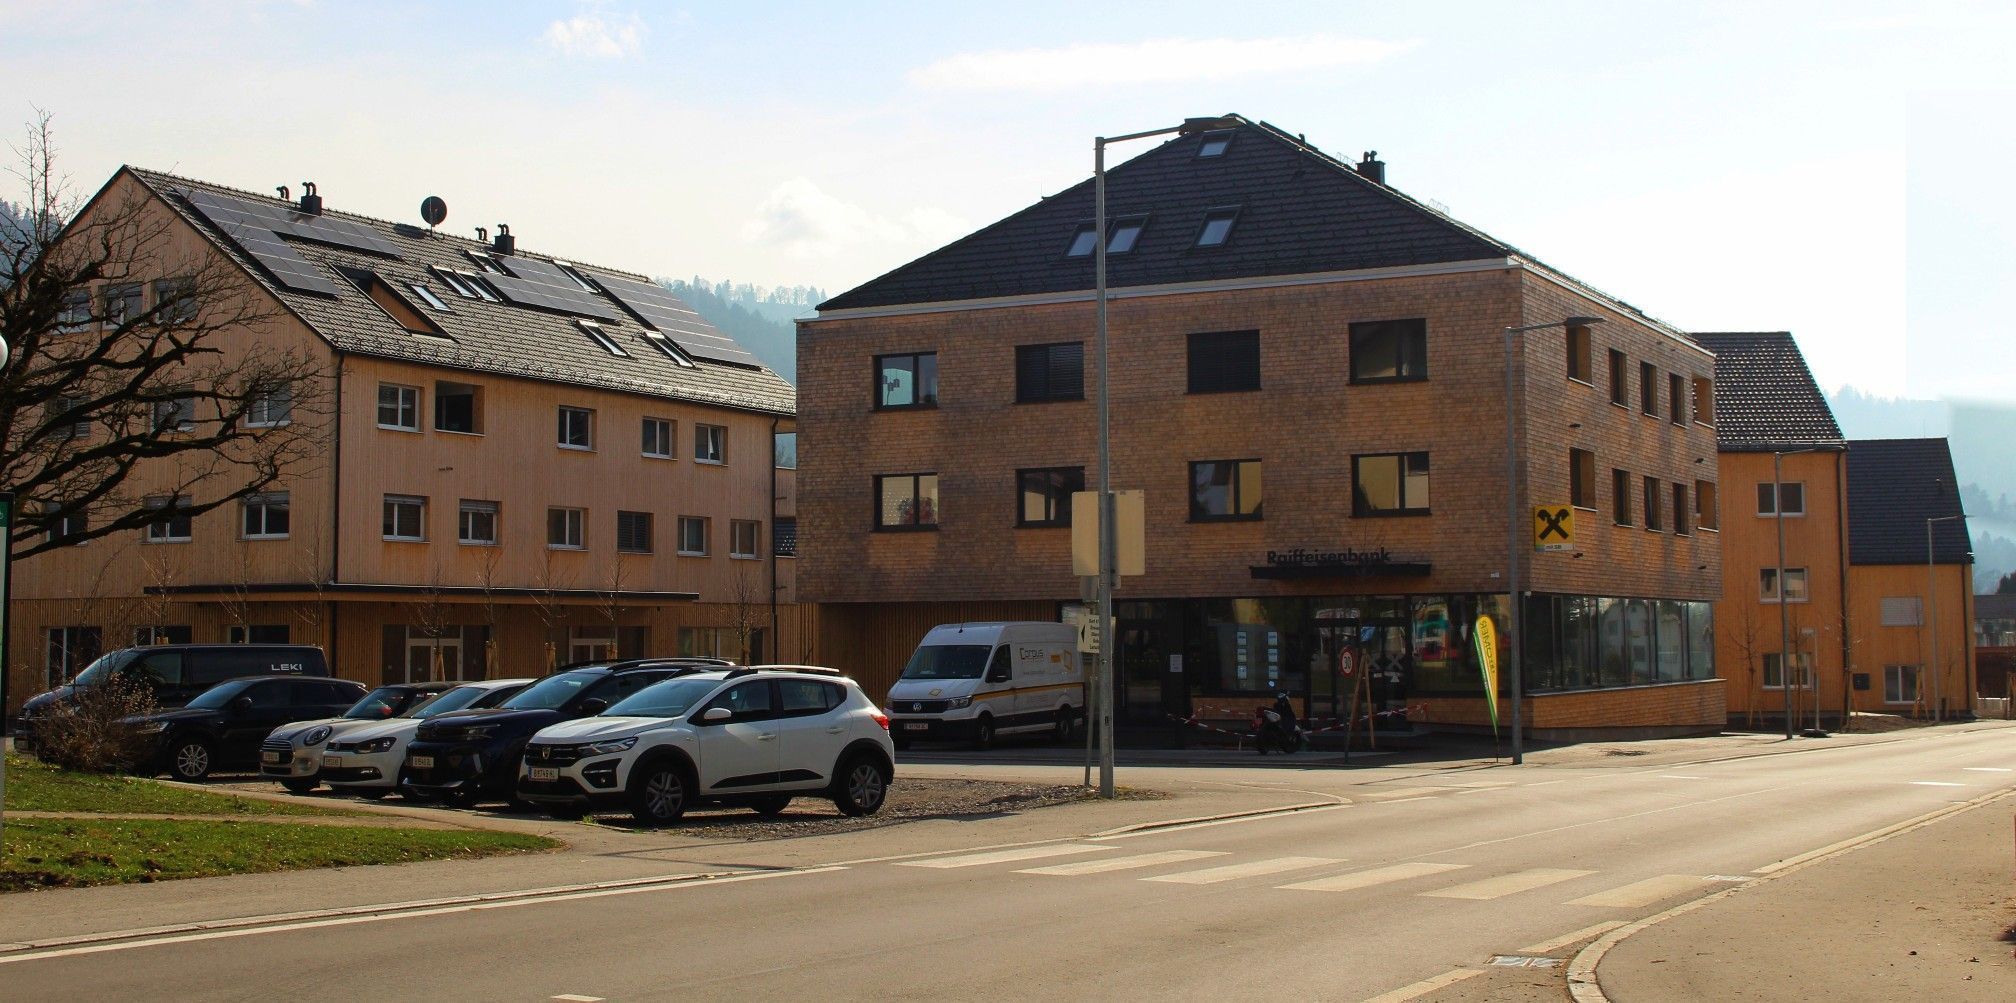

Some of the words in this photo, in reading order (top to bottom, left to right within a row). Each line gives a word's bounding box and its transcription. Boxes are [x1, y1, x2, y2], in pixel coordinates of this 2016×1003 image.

[1266, 546, 1392, 565] Raiffeisenbank
[271, 663, 303, 671] LEKI
[1343, 655, 1352, 670] 30
